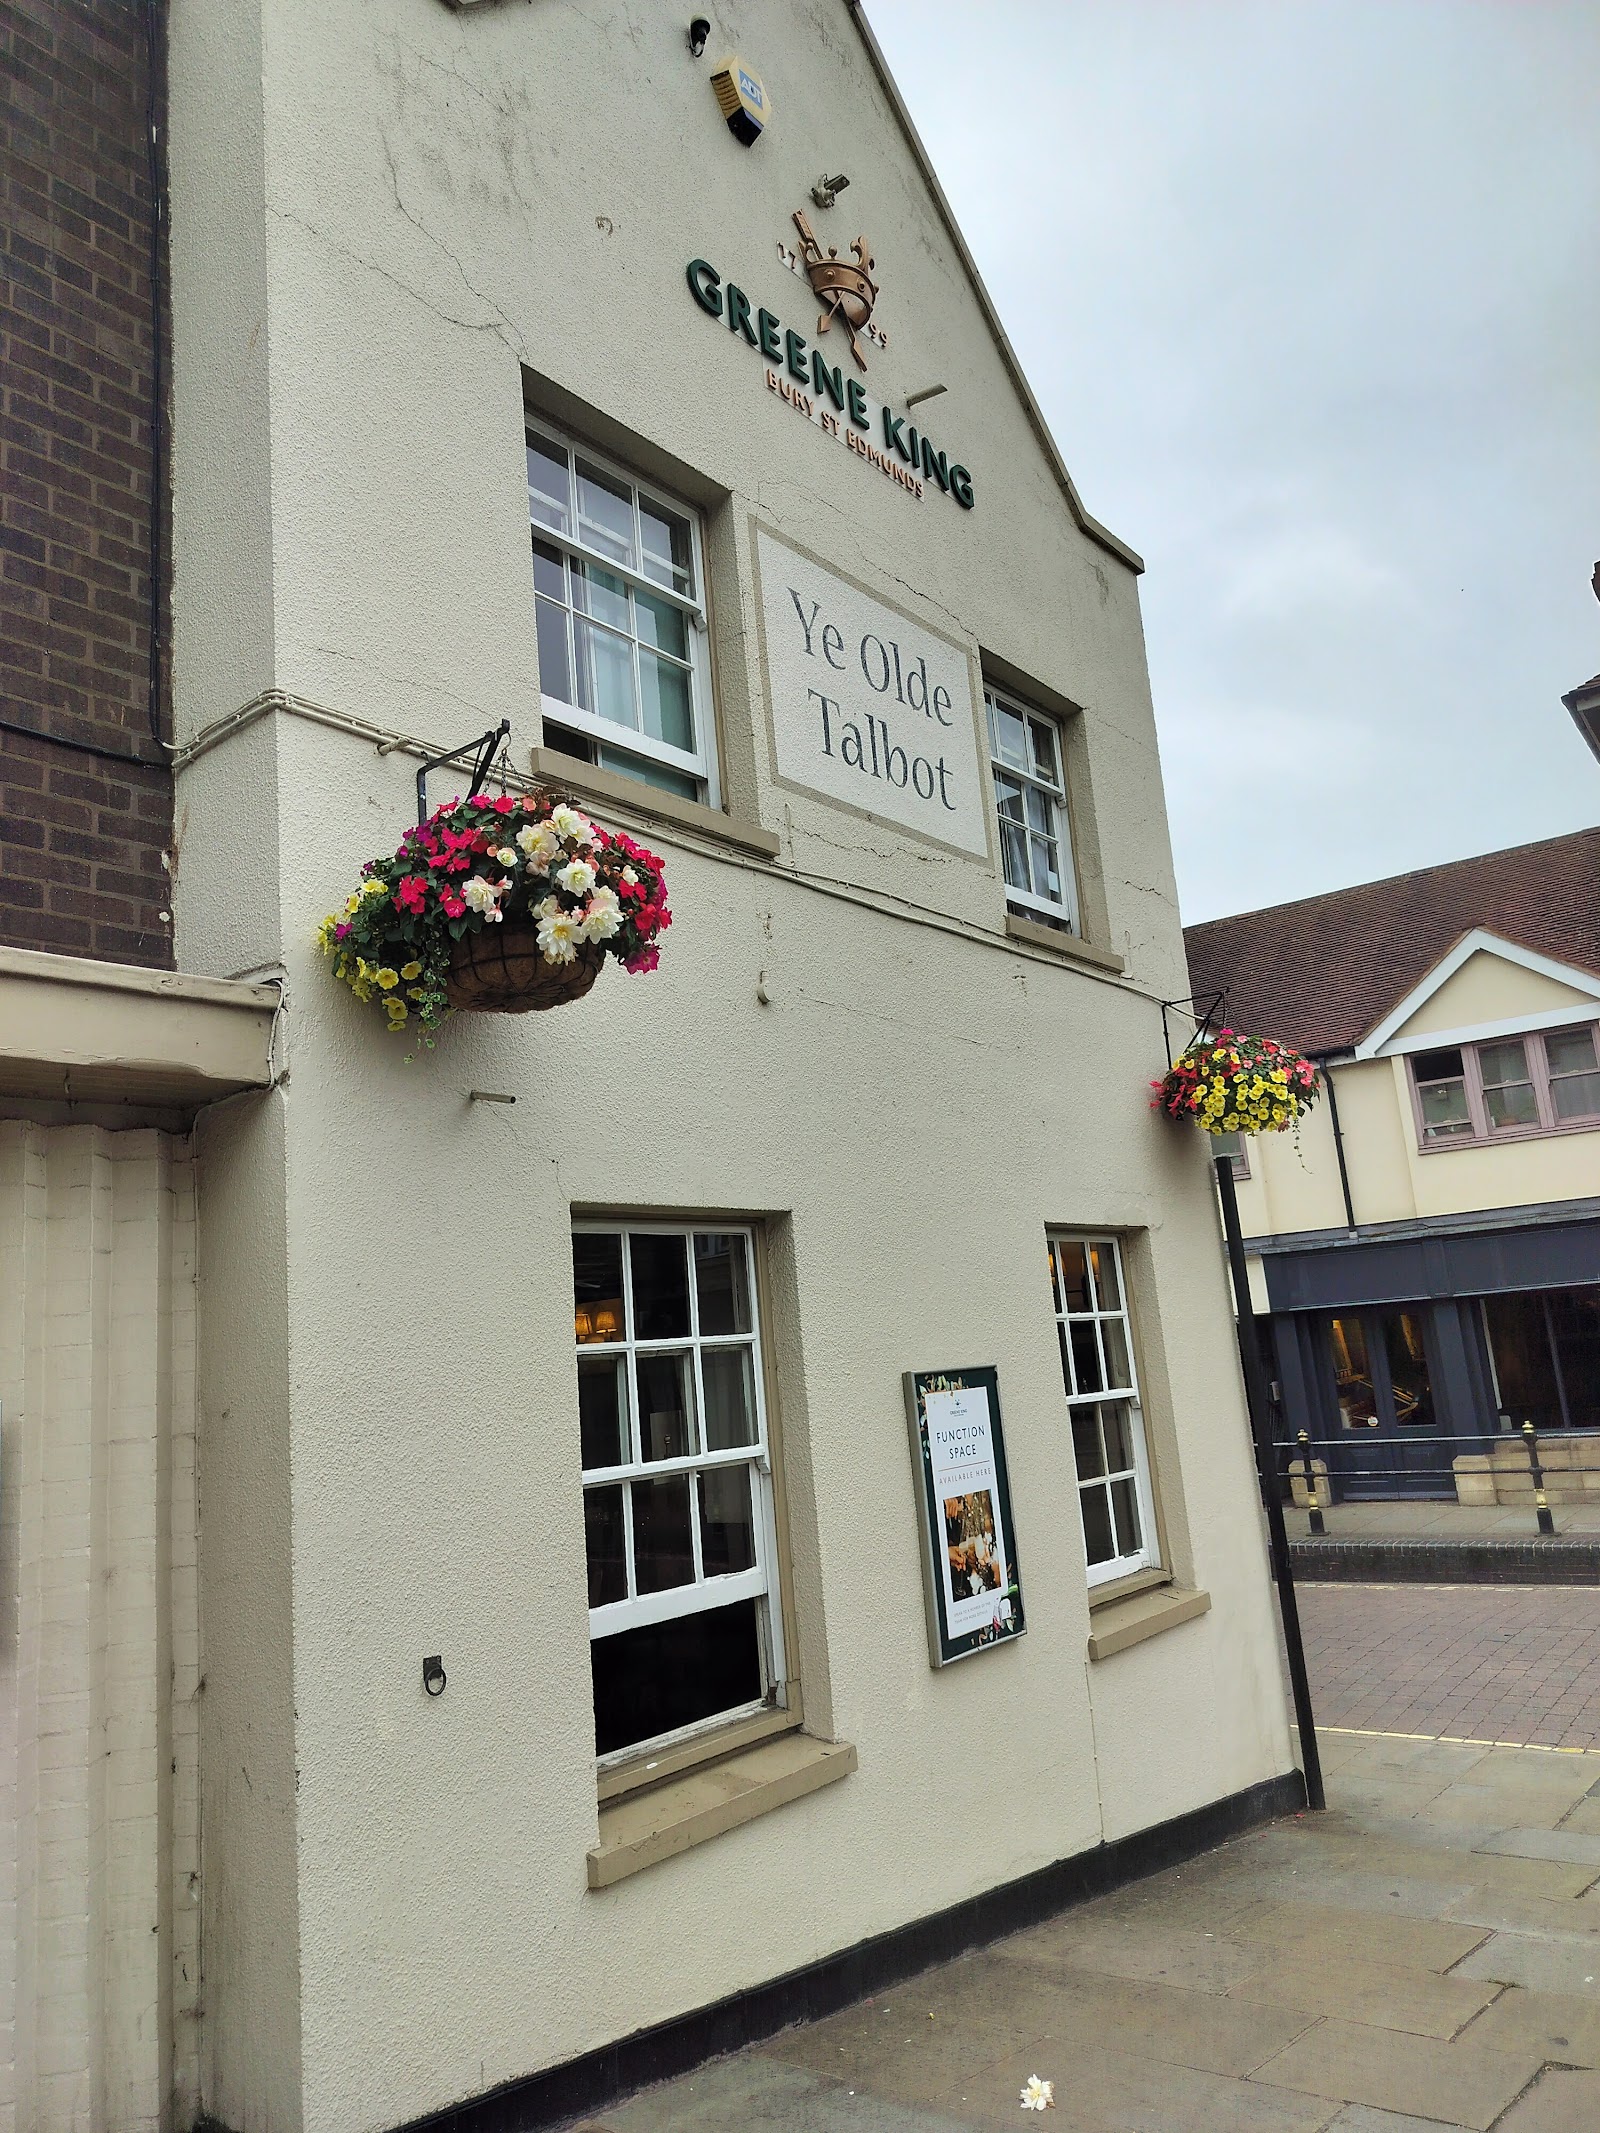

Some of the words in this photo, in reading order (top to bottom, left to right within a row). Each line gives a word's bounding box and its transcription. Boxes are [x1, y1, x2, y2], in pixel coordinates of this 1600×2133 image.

[741, 78, 762, 103] ADT
[868, 322, 887, 349] 99
[686, 259, 870, 431] GREENE
[882, 406, 975, 510] KING
[767, 368, 815, 417] BURY
[821, 410, 840, 436] ST
[846, 428, 924, 498] EDMUNDS
[787, 586, 846, 671] Ye
[860, 634, 953, 727] Olde
[807, 688, 956, 811] Talbot
[936, 1425, 985, 1443] FUNCTION
[949, 1444, 977, 1460] SPACE
[939, 1472, 973, 1484] AVAILABLE
[976, 1468, 991, 1477] HERE
